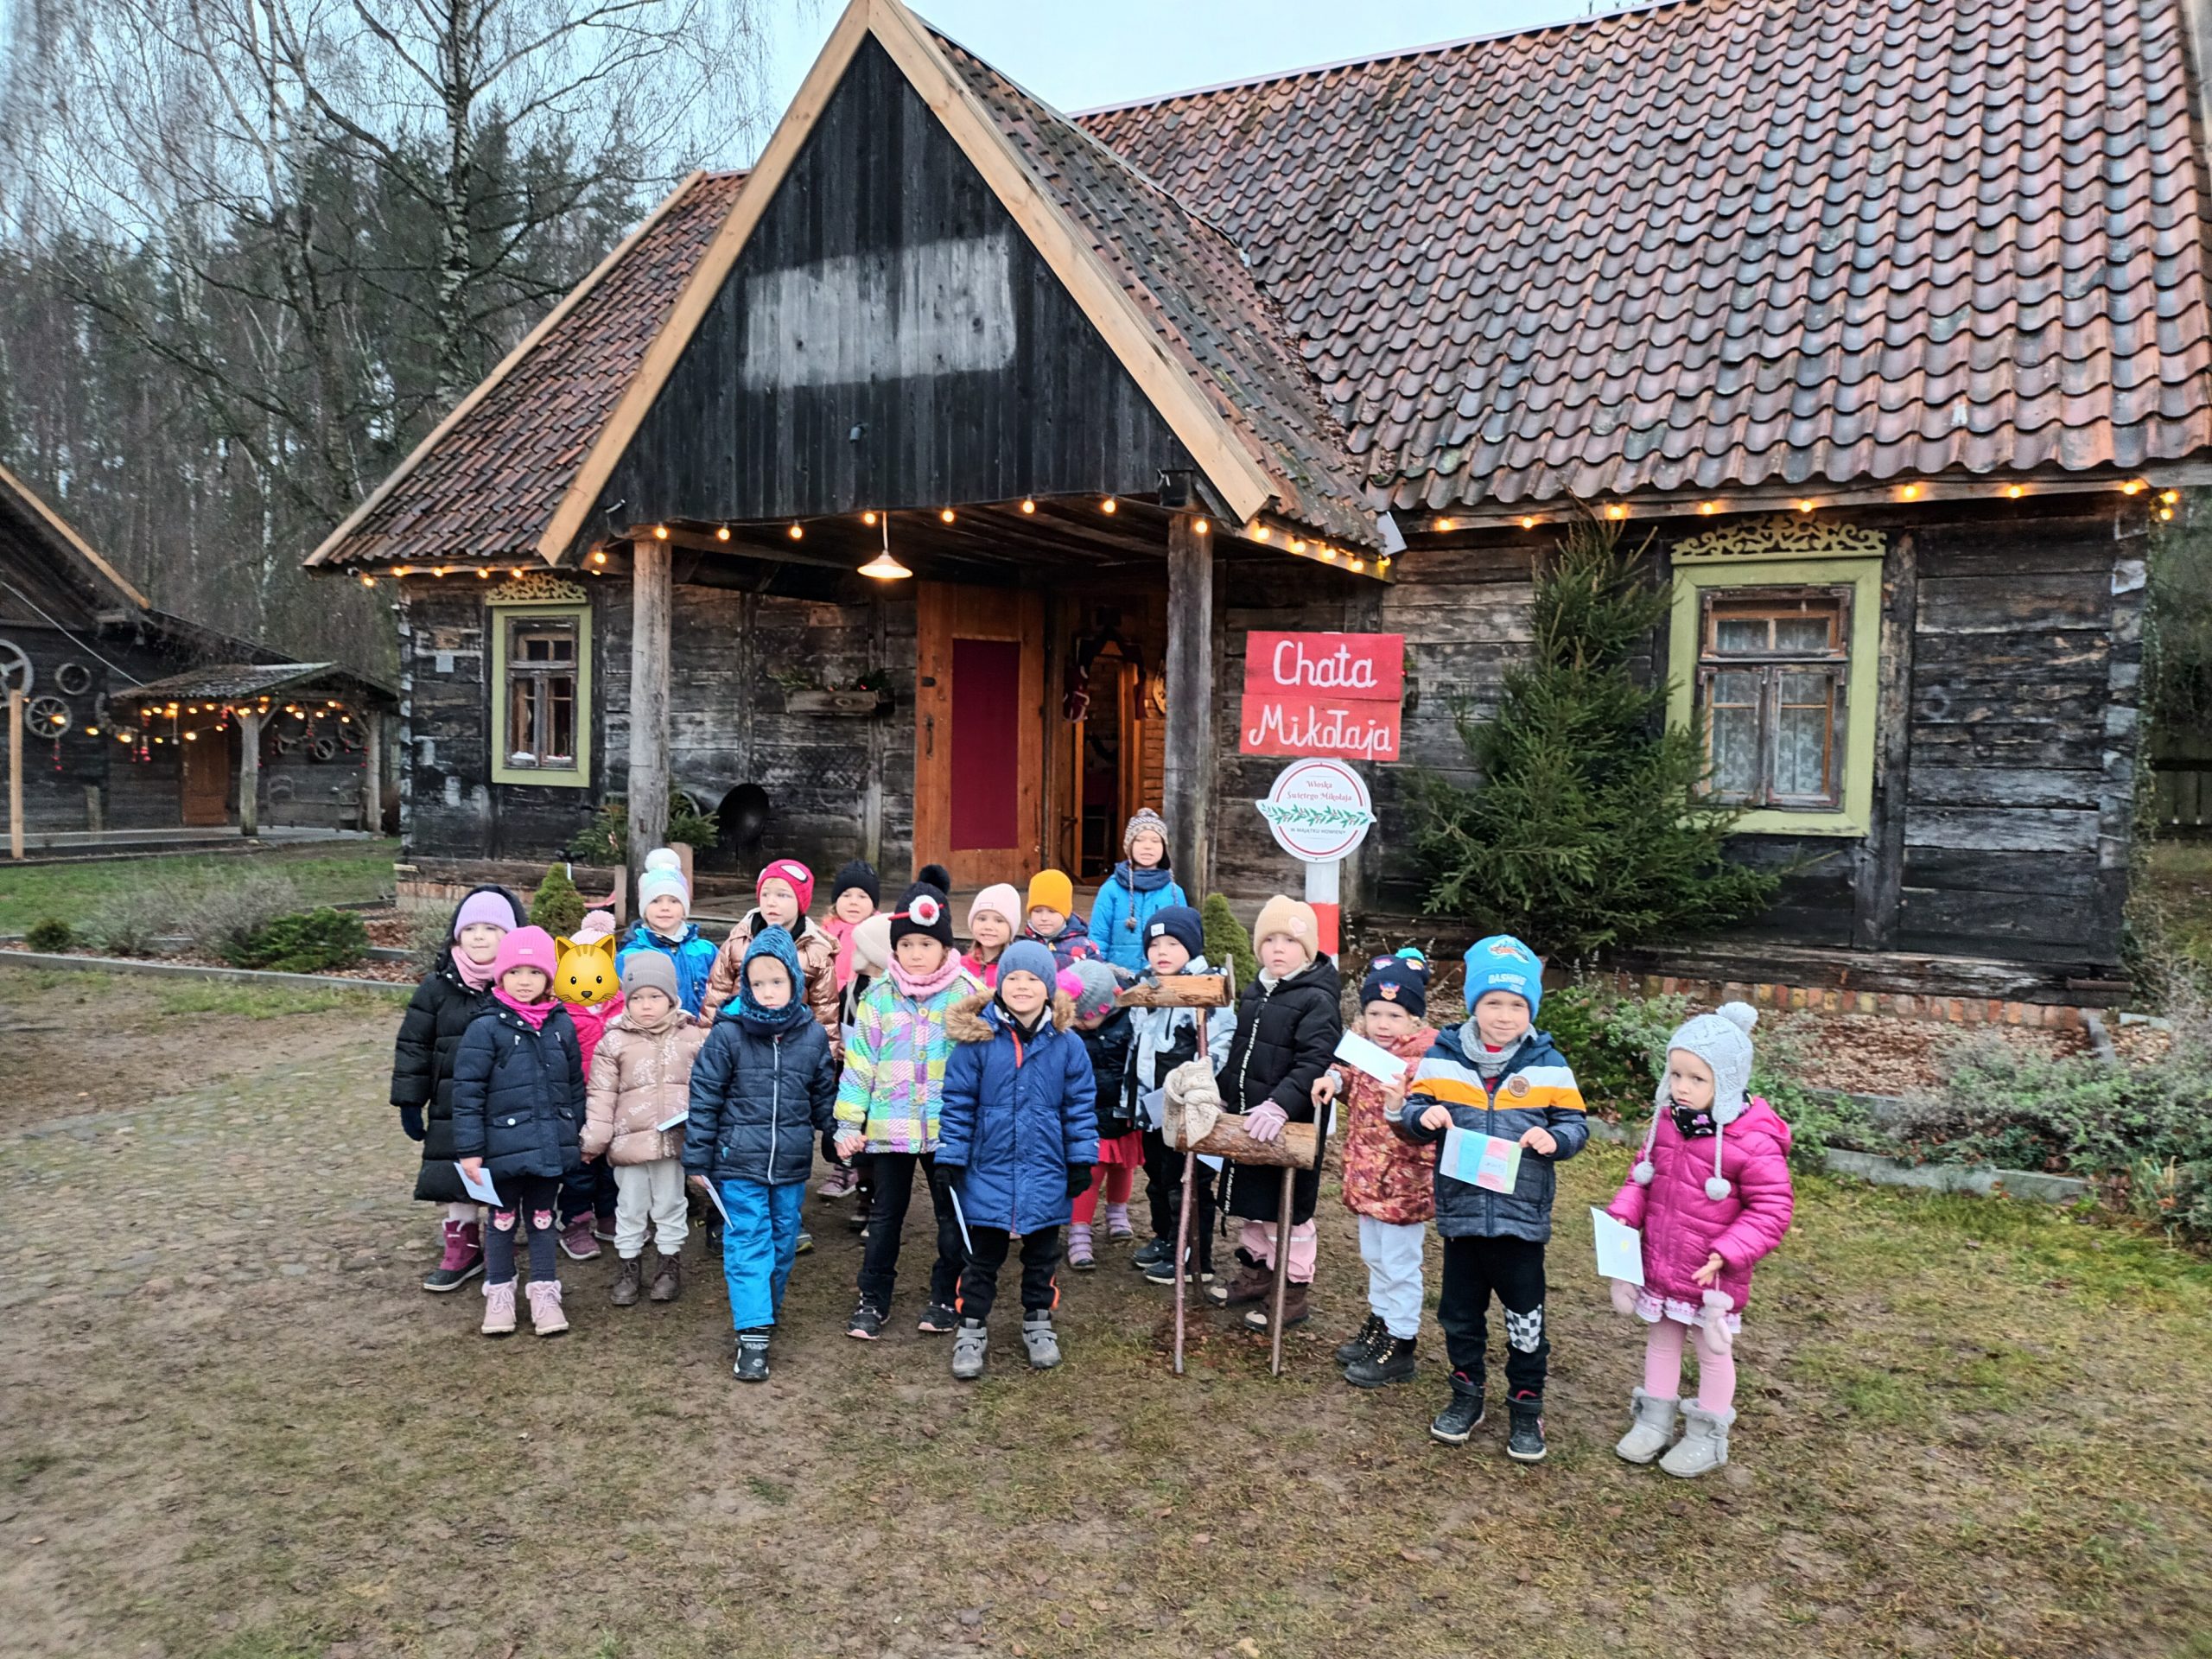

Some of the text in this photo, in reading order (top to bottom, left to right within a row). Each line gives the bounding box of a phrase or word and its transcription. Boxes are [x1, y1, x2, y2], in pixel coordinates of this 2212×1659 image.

[1273, 639, 1378, 689] Chata
[1249, 703, 1393, 760] Mikołaja
[1319, 791, 1352, 803] Mikołaja
